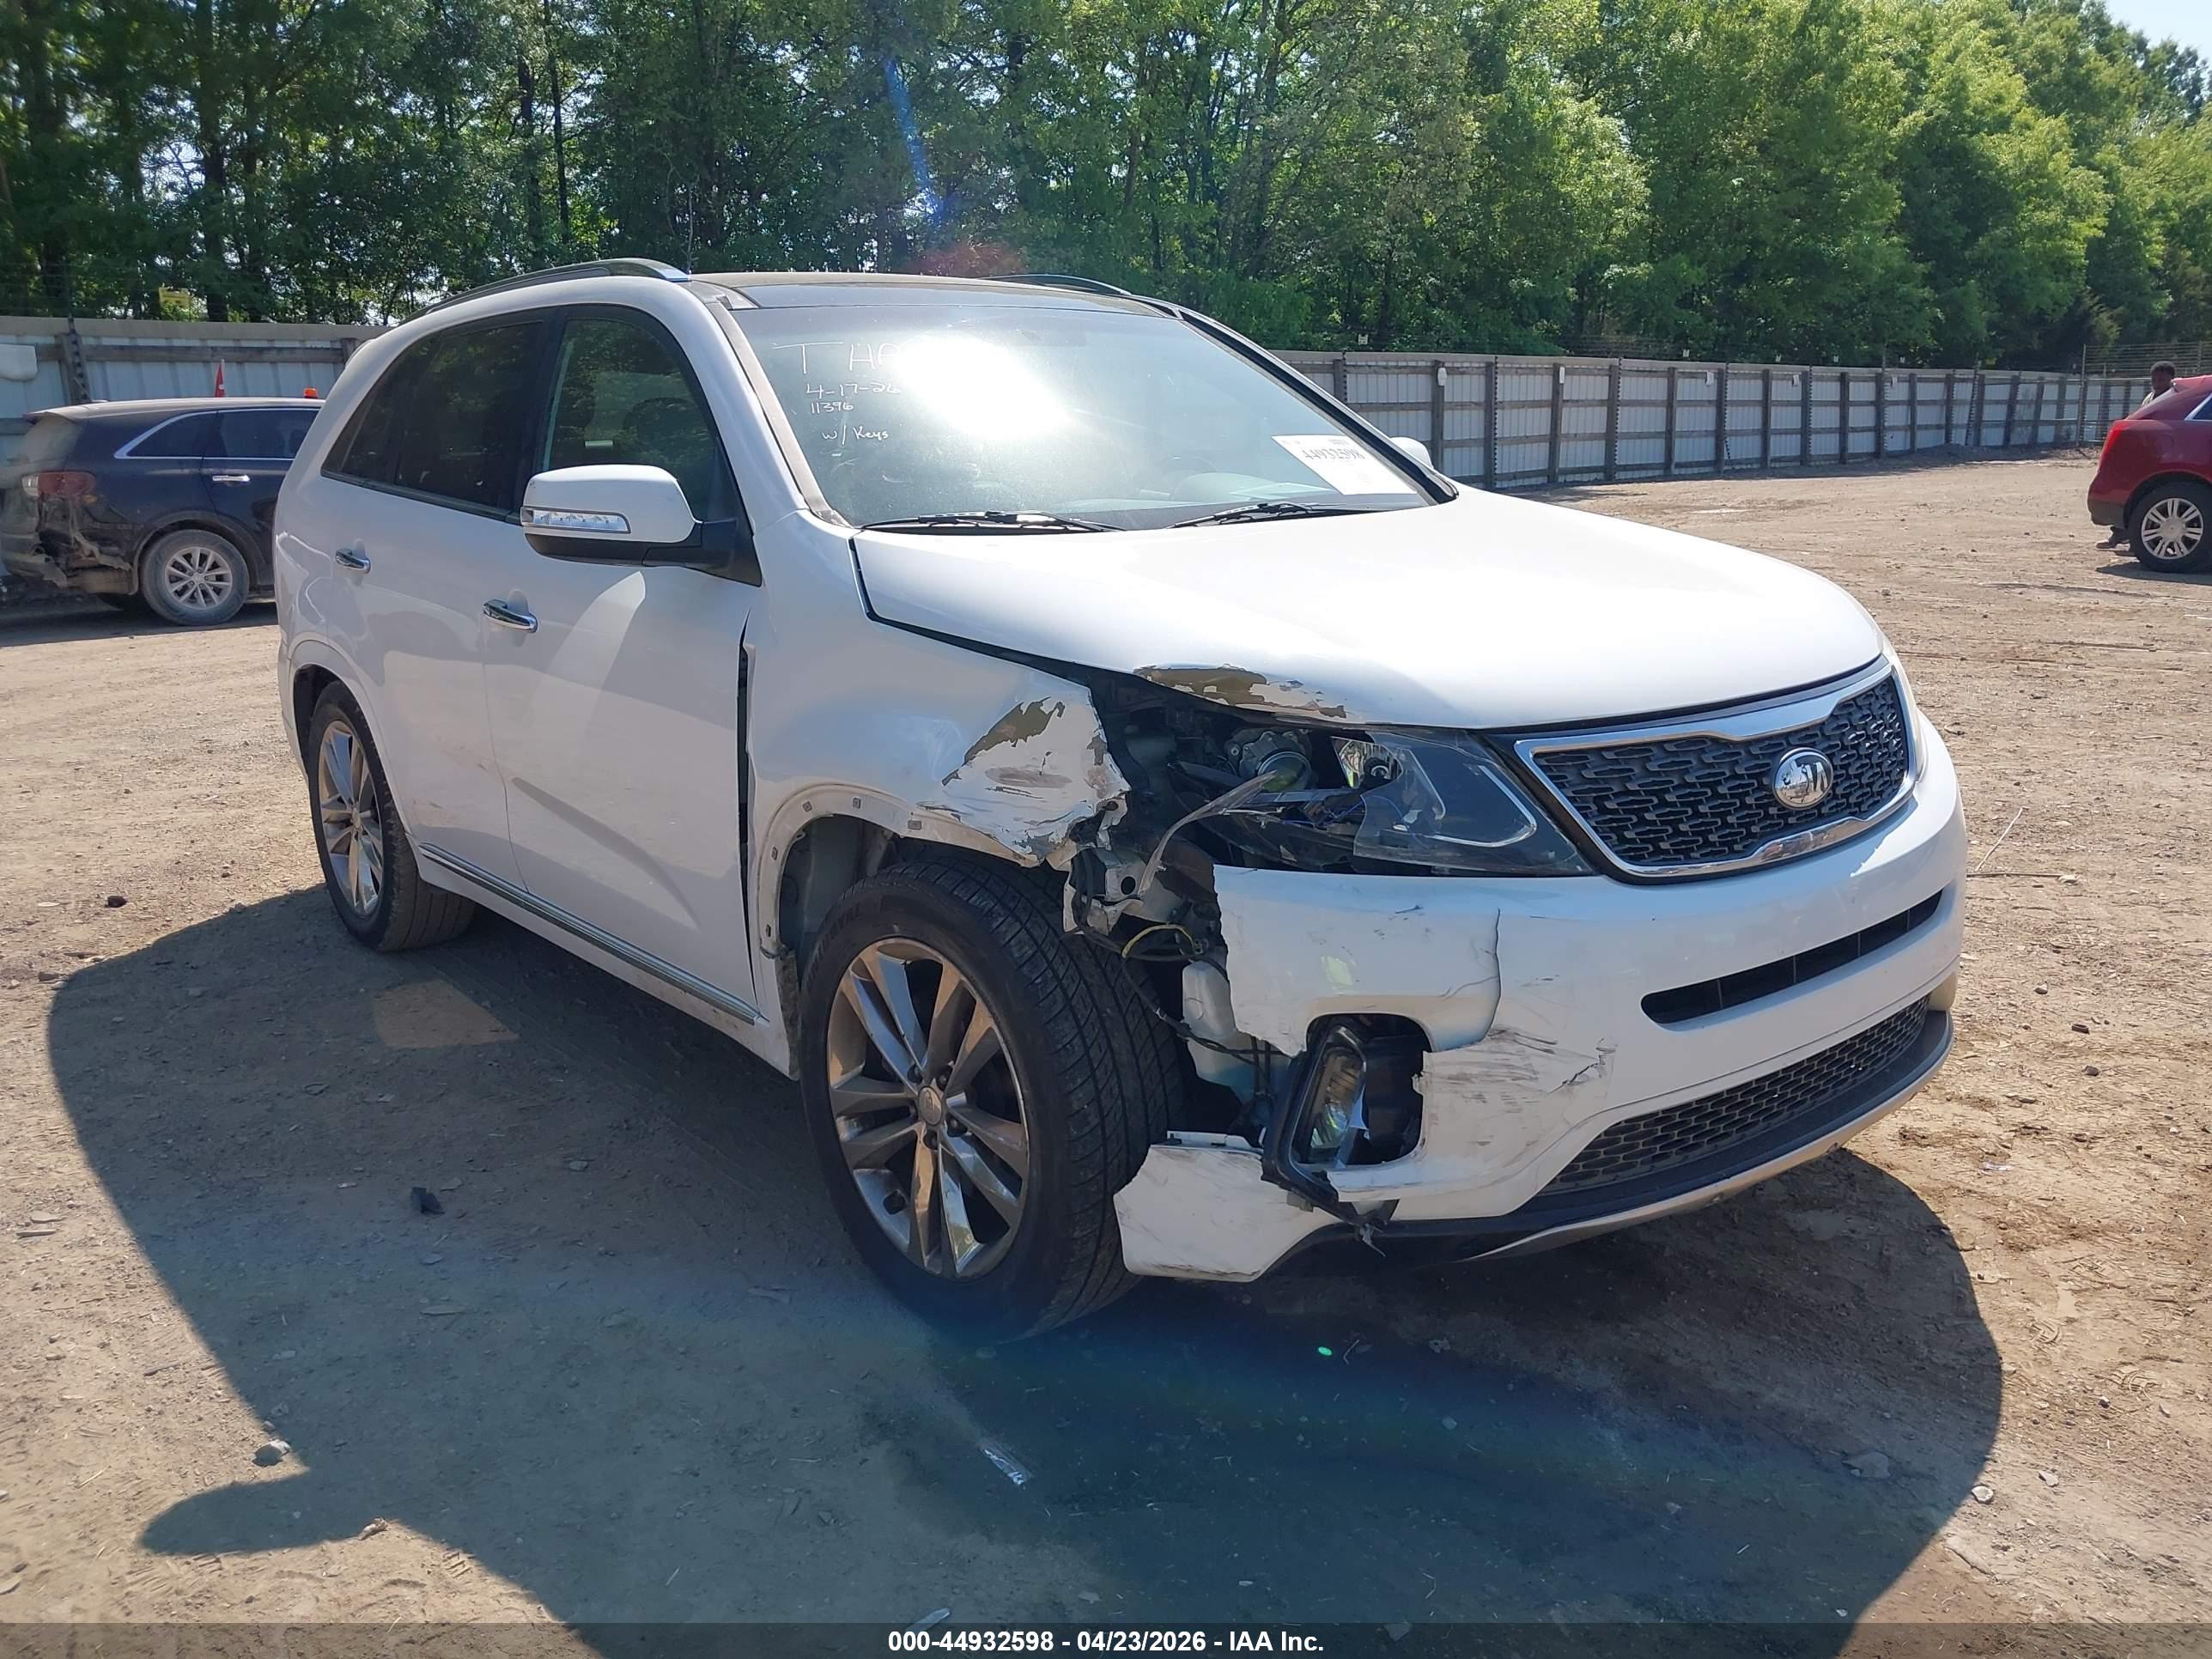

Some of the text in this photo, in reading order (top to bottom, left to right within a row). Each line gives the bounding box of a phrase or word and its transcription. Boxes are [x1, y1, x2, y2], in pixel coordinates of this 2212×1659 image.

[805, 382, 902, 398] 4-17-26
[810, 401, 854, 415] 11396
[853, 426, 890, 441] Keys
